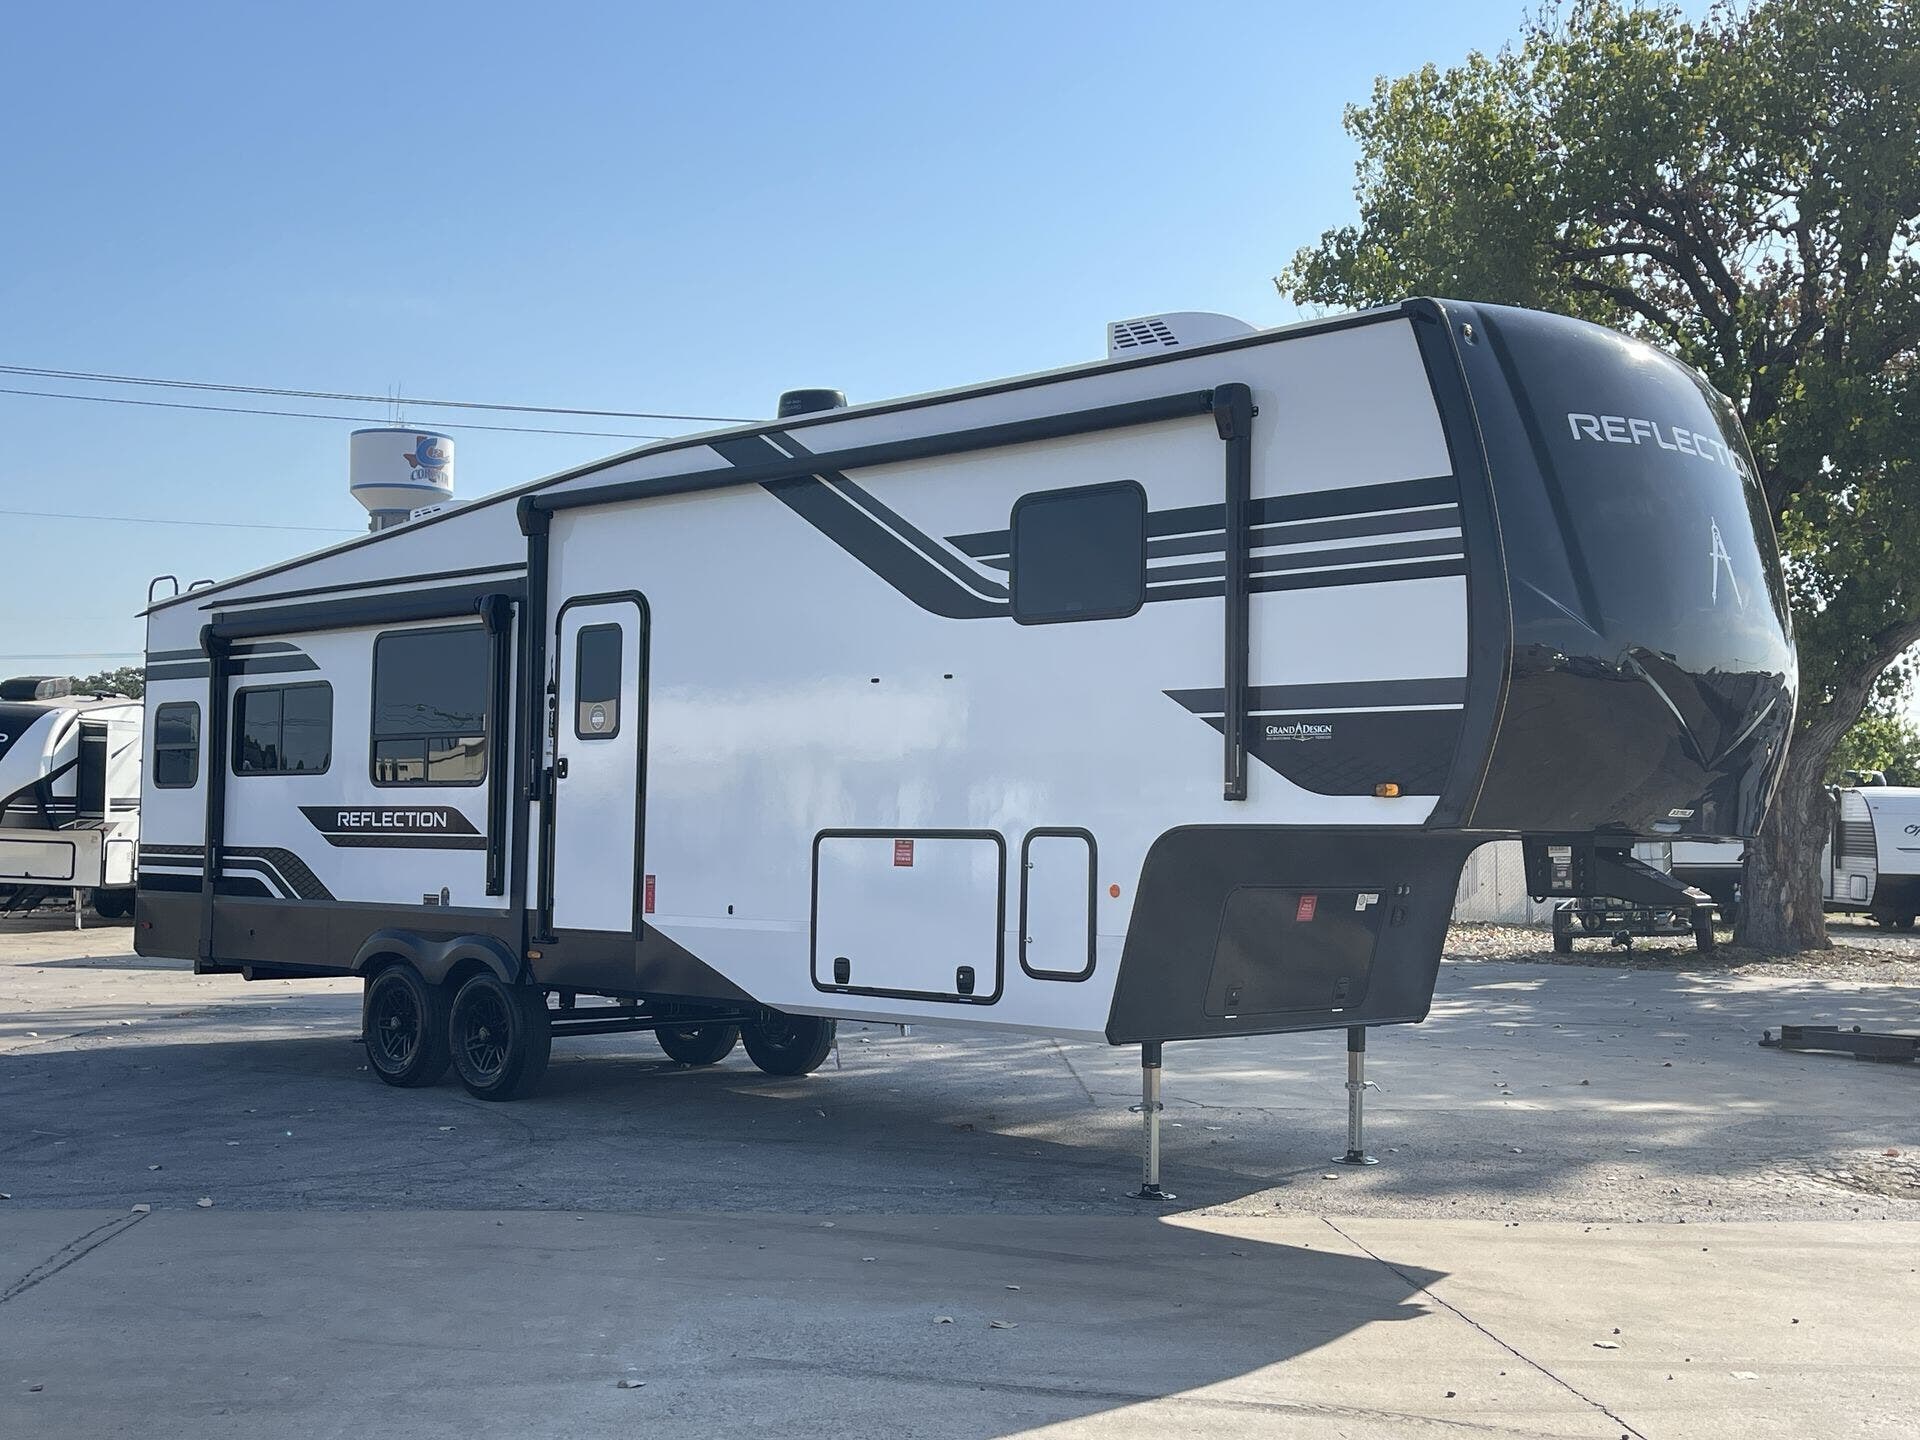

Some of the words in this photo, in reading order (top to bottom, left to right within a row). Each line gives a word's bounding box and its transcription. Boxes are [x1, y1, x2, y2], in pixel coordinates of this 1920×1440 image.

[1567, 413, 1757, 489] REFLECTION
[1266, 725, 1295, 734] GRAND
[1303, 724, 1332, 733] DESIGN
[337, 811, 447, 827] REFLECTION
